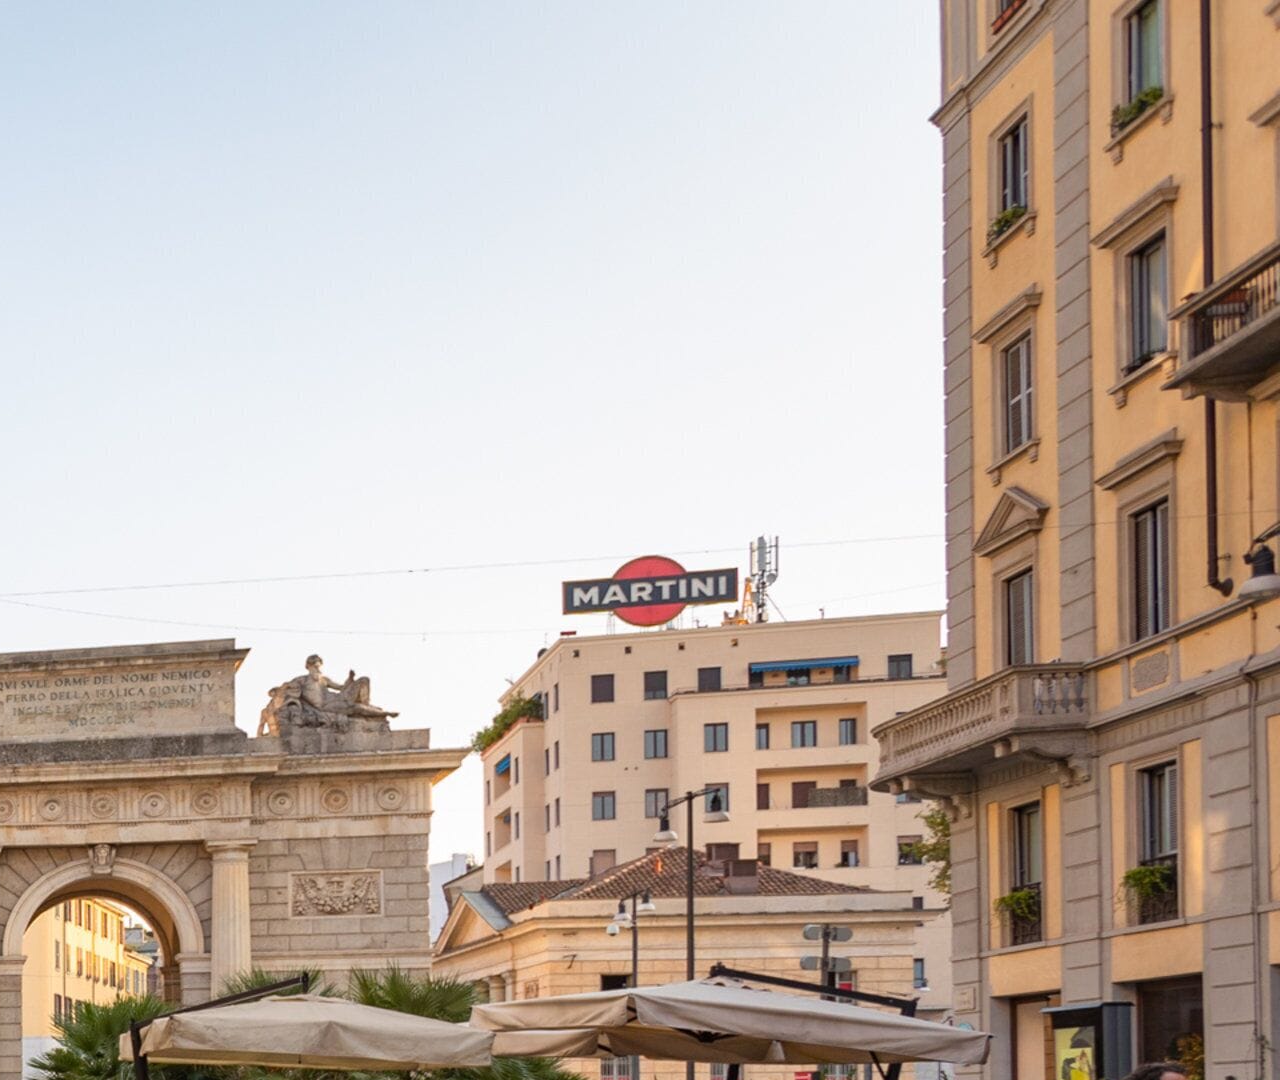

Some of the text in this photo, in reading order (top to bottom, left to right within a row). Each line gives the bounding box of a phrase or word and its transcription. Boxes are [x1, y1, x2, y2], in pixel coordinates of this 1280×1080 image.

[573, 576, 727, 607] MARTINI
[162, 670, 211, 681] NEMICO
[6, 692, 47, 703] FERRO
[50, 691, 90, 701] DELLA
